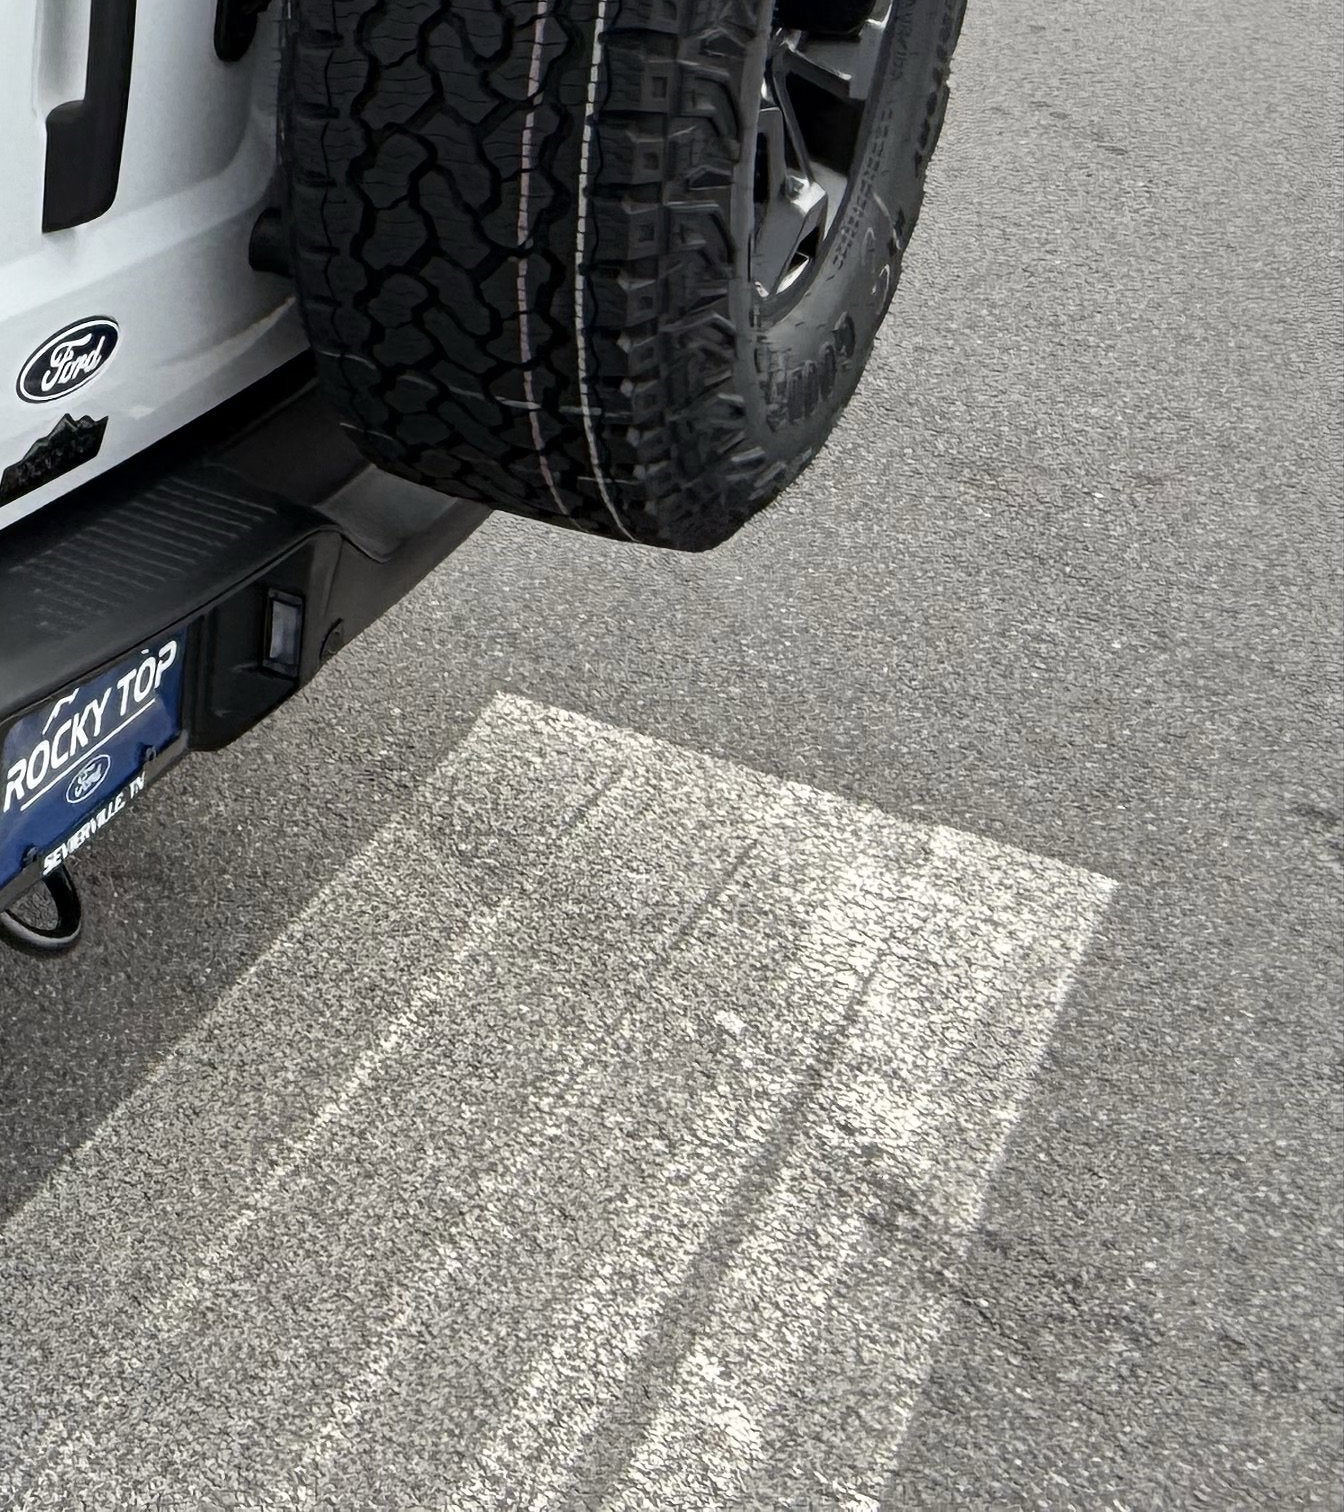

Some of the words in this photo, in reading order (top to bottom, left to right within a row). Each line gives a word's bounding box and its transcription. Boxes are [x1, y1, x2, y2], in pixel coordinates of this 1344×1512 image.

[41, 332, 106, 392] Ford
[3, 687, 111, 813] ROCKY
[116, 640, 177, 716] TOP
